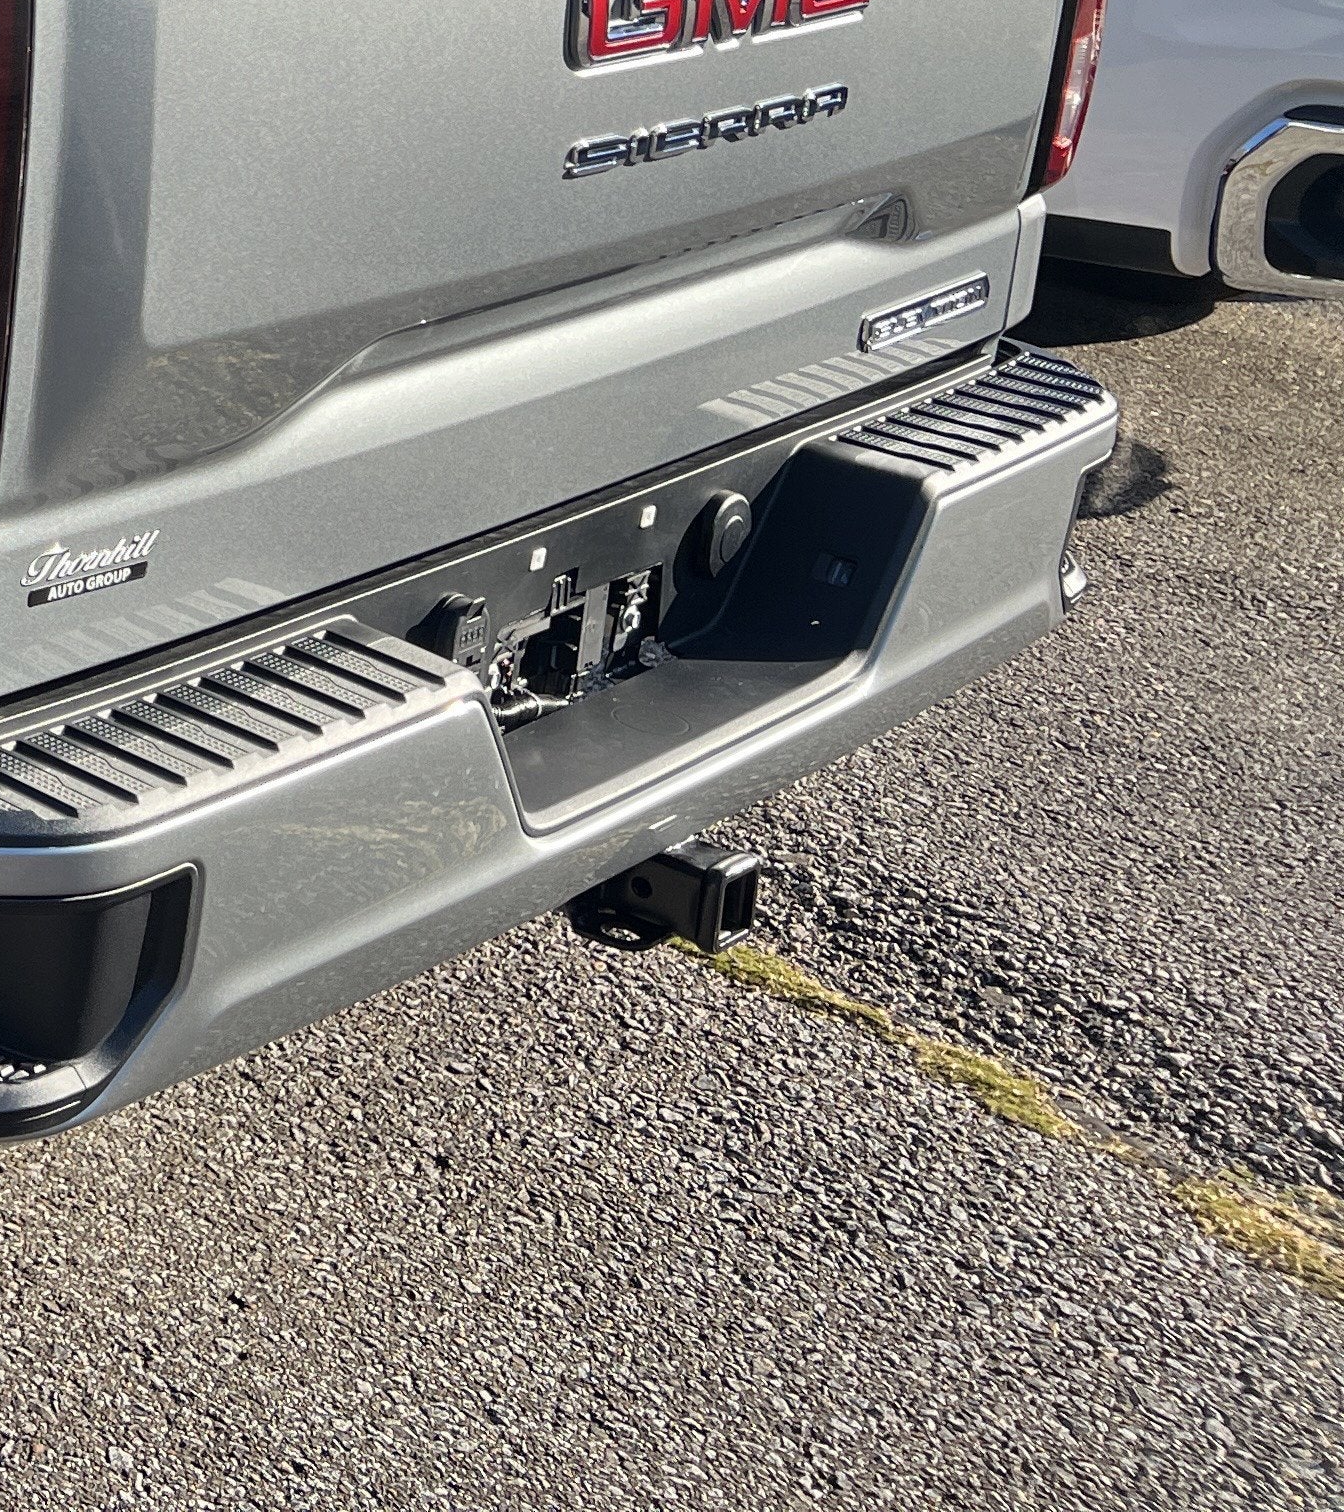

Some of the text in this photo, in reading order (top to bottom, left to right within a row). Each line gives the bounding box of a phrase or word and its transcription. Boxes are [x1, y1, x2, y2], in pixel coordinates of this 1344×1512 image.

[562, 82, 849, 180] SIERRA
[20, 529, 160, 586] Thornhill
[47, 567, 131, 601] AUTO GROUP
